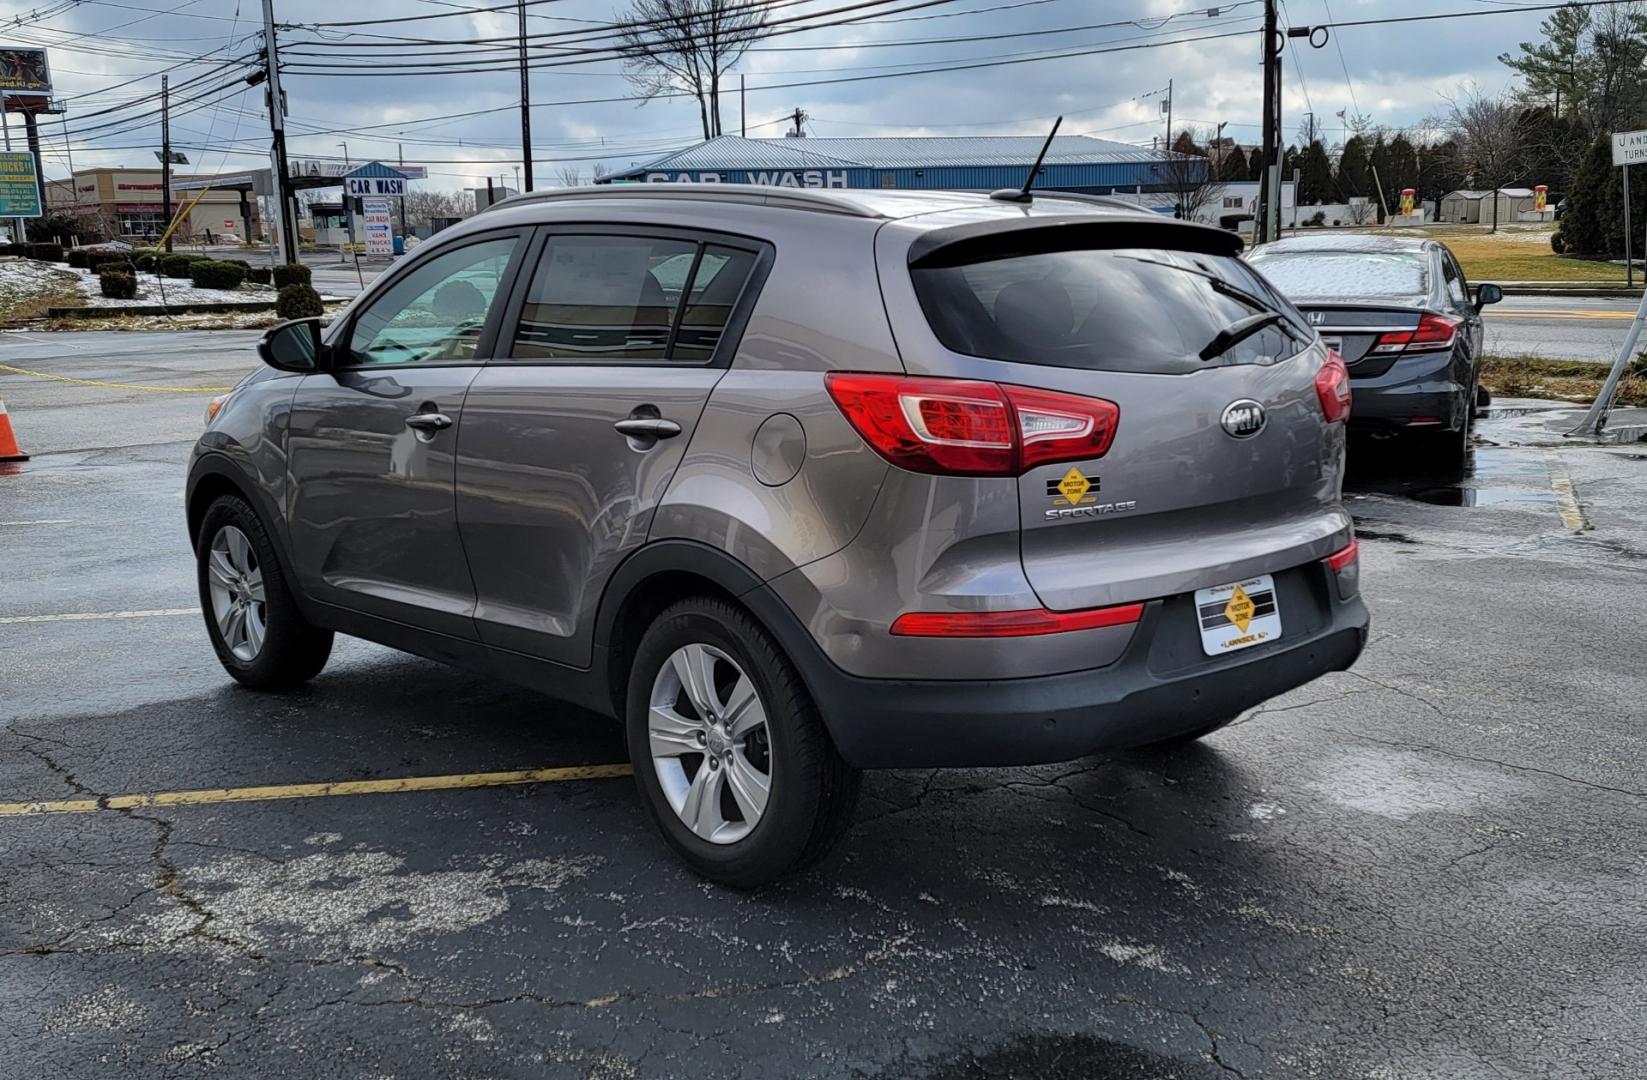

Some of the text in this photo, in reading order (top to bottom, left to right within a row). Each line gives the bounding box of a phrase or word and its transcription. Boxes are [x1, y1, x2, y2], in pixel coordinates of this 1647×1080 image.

[350, 179, 403, 194] CAR WASH
[746, 170, 848, 189] WASH
[1045, 501, 1136, 521] SPORTAGE
